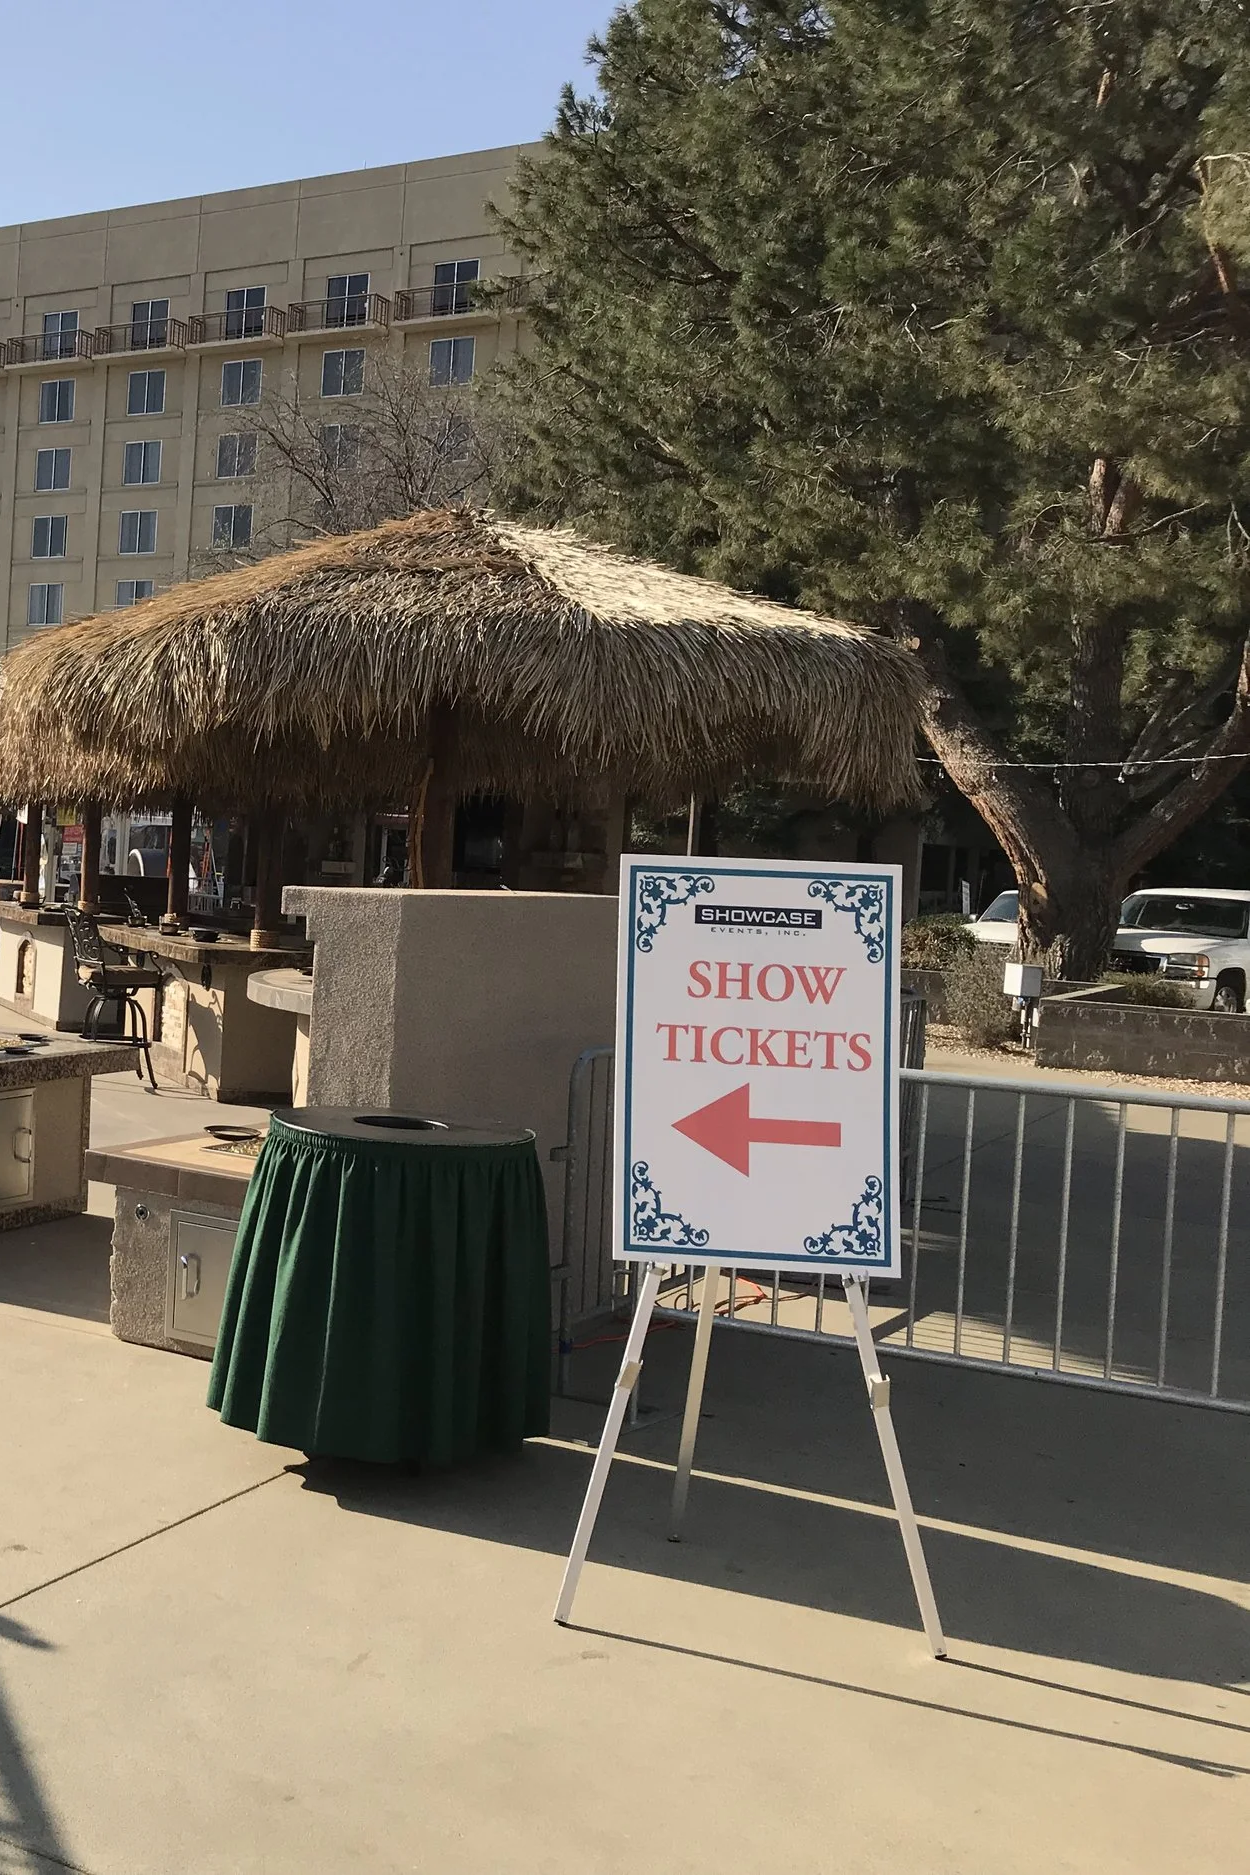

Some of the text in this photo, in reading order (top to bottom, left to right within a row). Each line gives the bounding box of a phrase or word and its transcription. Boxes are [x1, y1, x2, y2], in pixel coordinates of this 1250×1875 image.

[701, 908, 816, 926] SHOWCASE
[710, 926, 769, 936] EVENTS,
[687, 960, 847, 1005] SHOW
[656, 1023, 872, 1072] TICKETS
